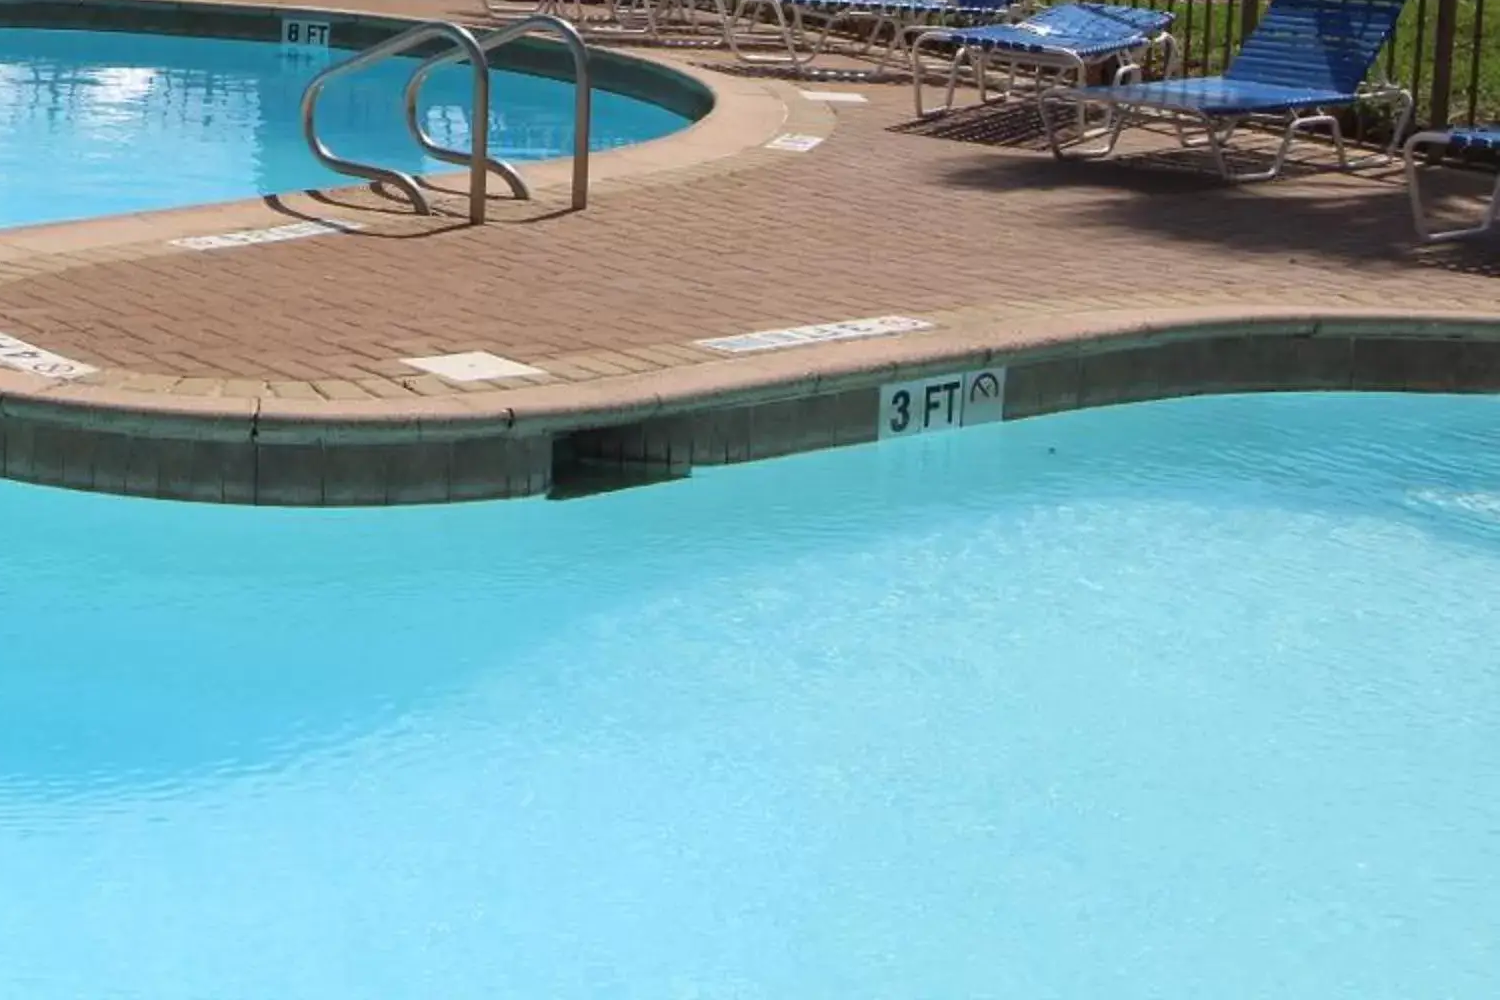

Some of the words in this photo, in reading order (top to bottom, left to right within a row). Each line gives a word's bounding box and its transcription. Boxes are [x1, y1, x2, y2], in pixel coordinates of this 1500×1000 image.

[288, 23, 300, 43] 8
[307, 24, 328, 45] FT
[889, 389, 911, 433] 3
[923, 381, 961, 429] FT
